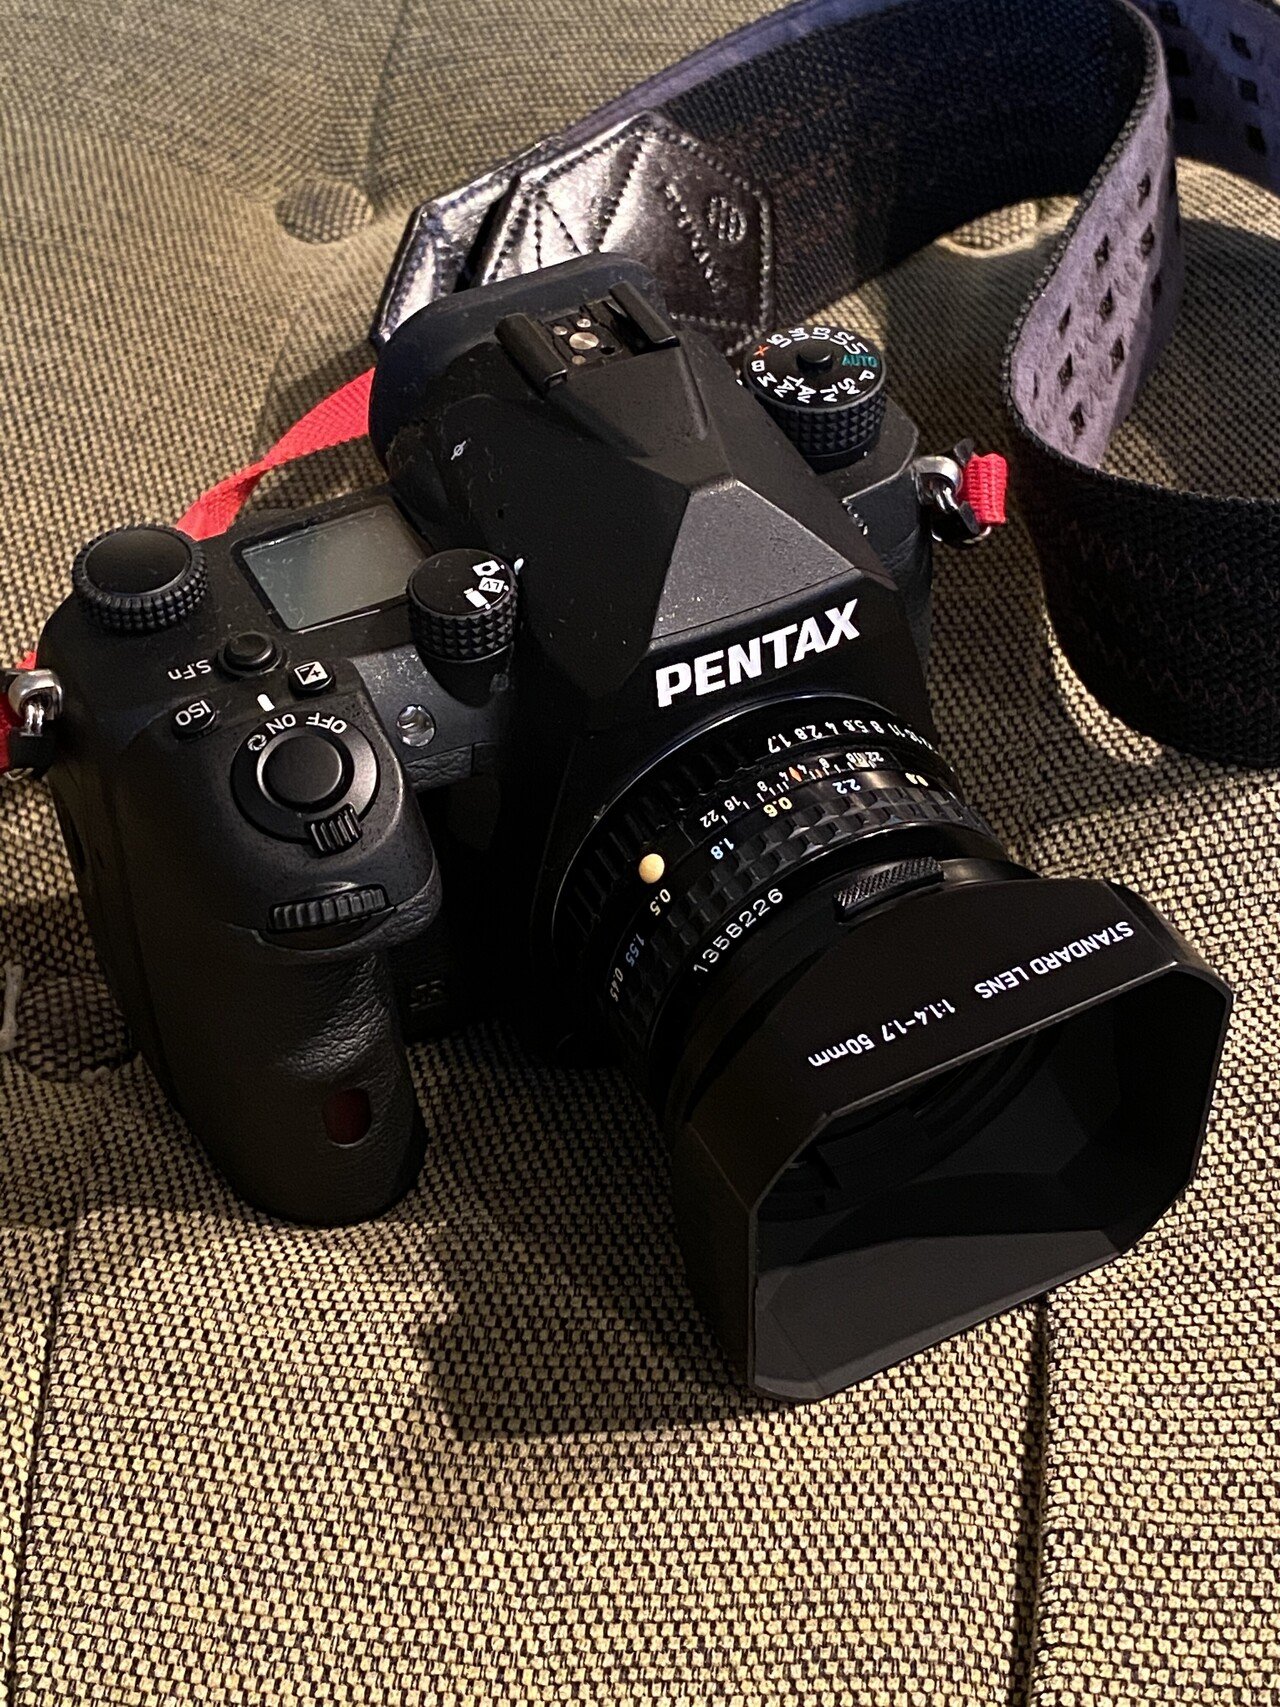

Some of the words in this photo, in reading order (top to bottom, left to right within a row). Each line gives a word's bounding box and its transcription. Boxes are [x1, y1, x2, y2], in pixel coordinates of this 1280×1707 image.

[844, 342, 869, 355] U1
[751, 360, 765, 372] B
[841, 354, 878, 368] AUTO
[757, 372, 777, 387] M
[859, 369, 875, 381] P
[655, 598, 860, 708] PENTAX
[168, 659, 212, 681] S.Fn
[175, 700, 212, 726] ISO
[305, 712, 348, 734] OFF
[265, 713, 297, 735] ON
[794, 725, 822, 740] 2.8
[825, 722, 839, 735] 4
[870, 720, 884, 734] 8
[767, 733, 791, 753] 1.7
[832, 778, 861, 794] 2.2
[763, 797, 793, 817] 0.6
[700, 809, 719, 828] 22
[711, 838, 734, 859] 1.8
[650, 889, 671, 916] 0.5
[693, 888, 783, 973] 1358226
[625, 933, 645, 967] 1.55
[1029, 920, 1135, 975] STANDARD
[973, 966, 1030, 999] LENS
[807, 1033, 875, 1067] 50mm
